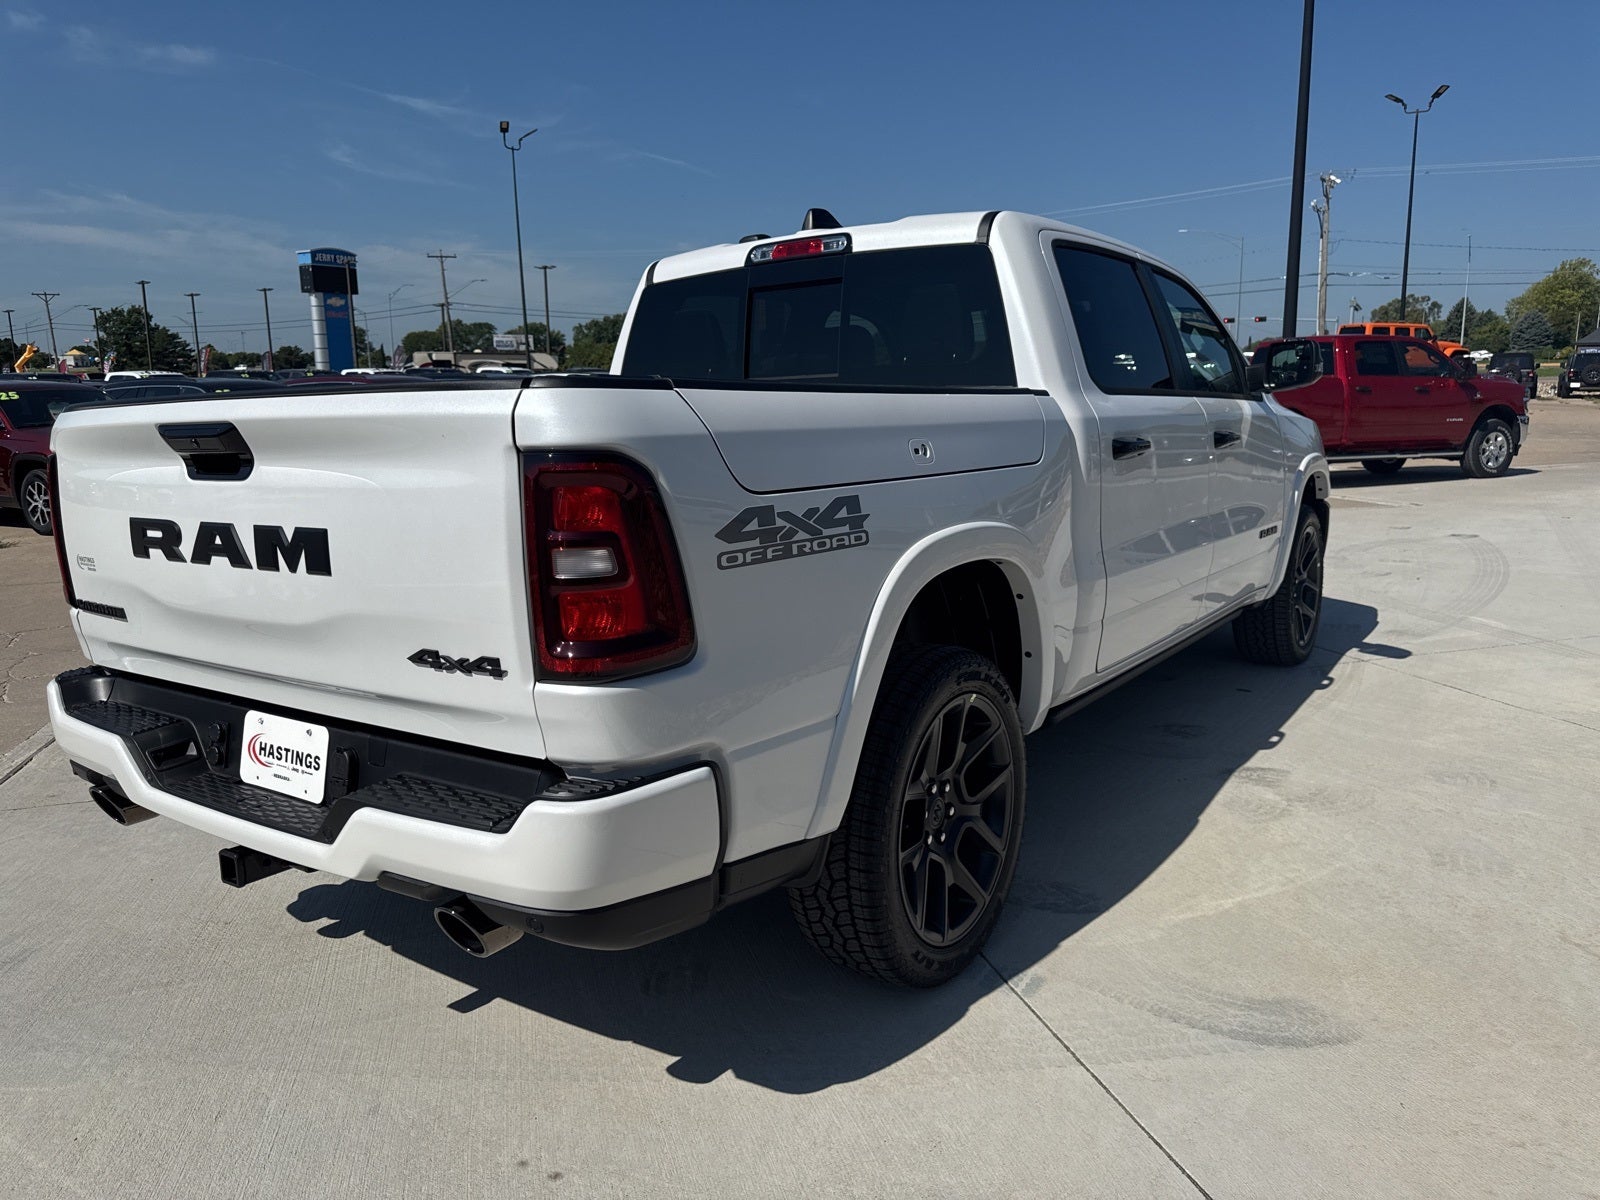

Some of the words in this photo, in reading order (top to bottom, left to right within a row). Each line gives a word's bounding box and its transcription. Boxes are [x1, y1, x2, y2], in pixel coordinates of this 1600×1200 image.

[315, 253, 335, 262] JERRY
[129, 517, 332, 577] RAM
[720, 545, 785, 567] OFF
[791, 533, 867, 556] ROAD
[406, 648, 509, 681] 4x4
[258, 740, 321, 771] HASTINGS
